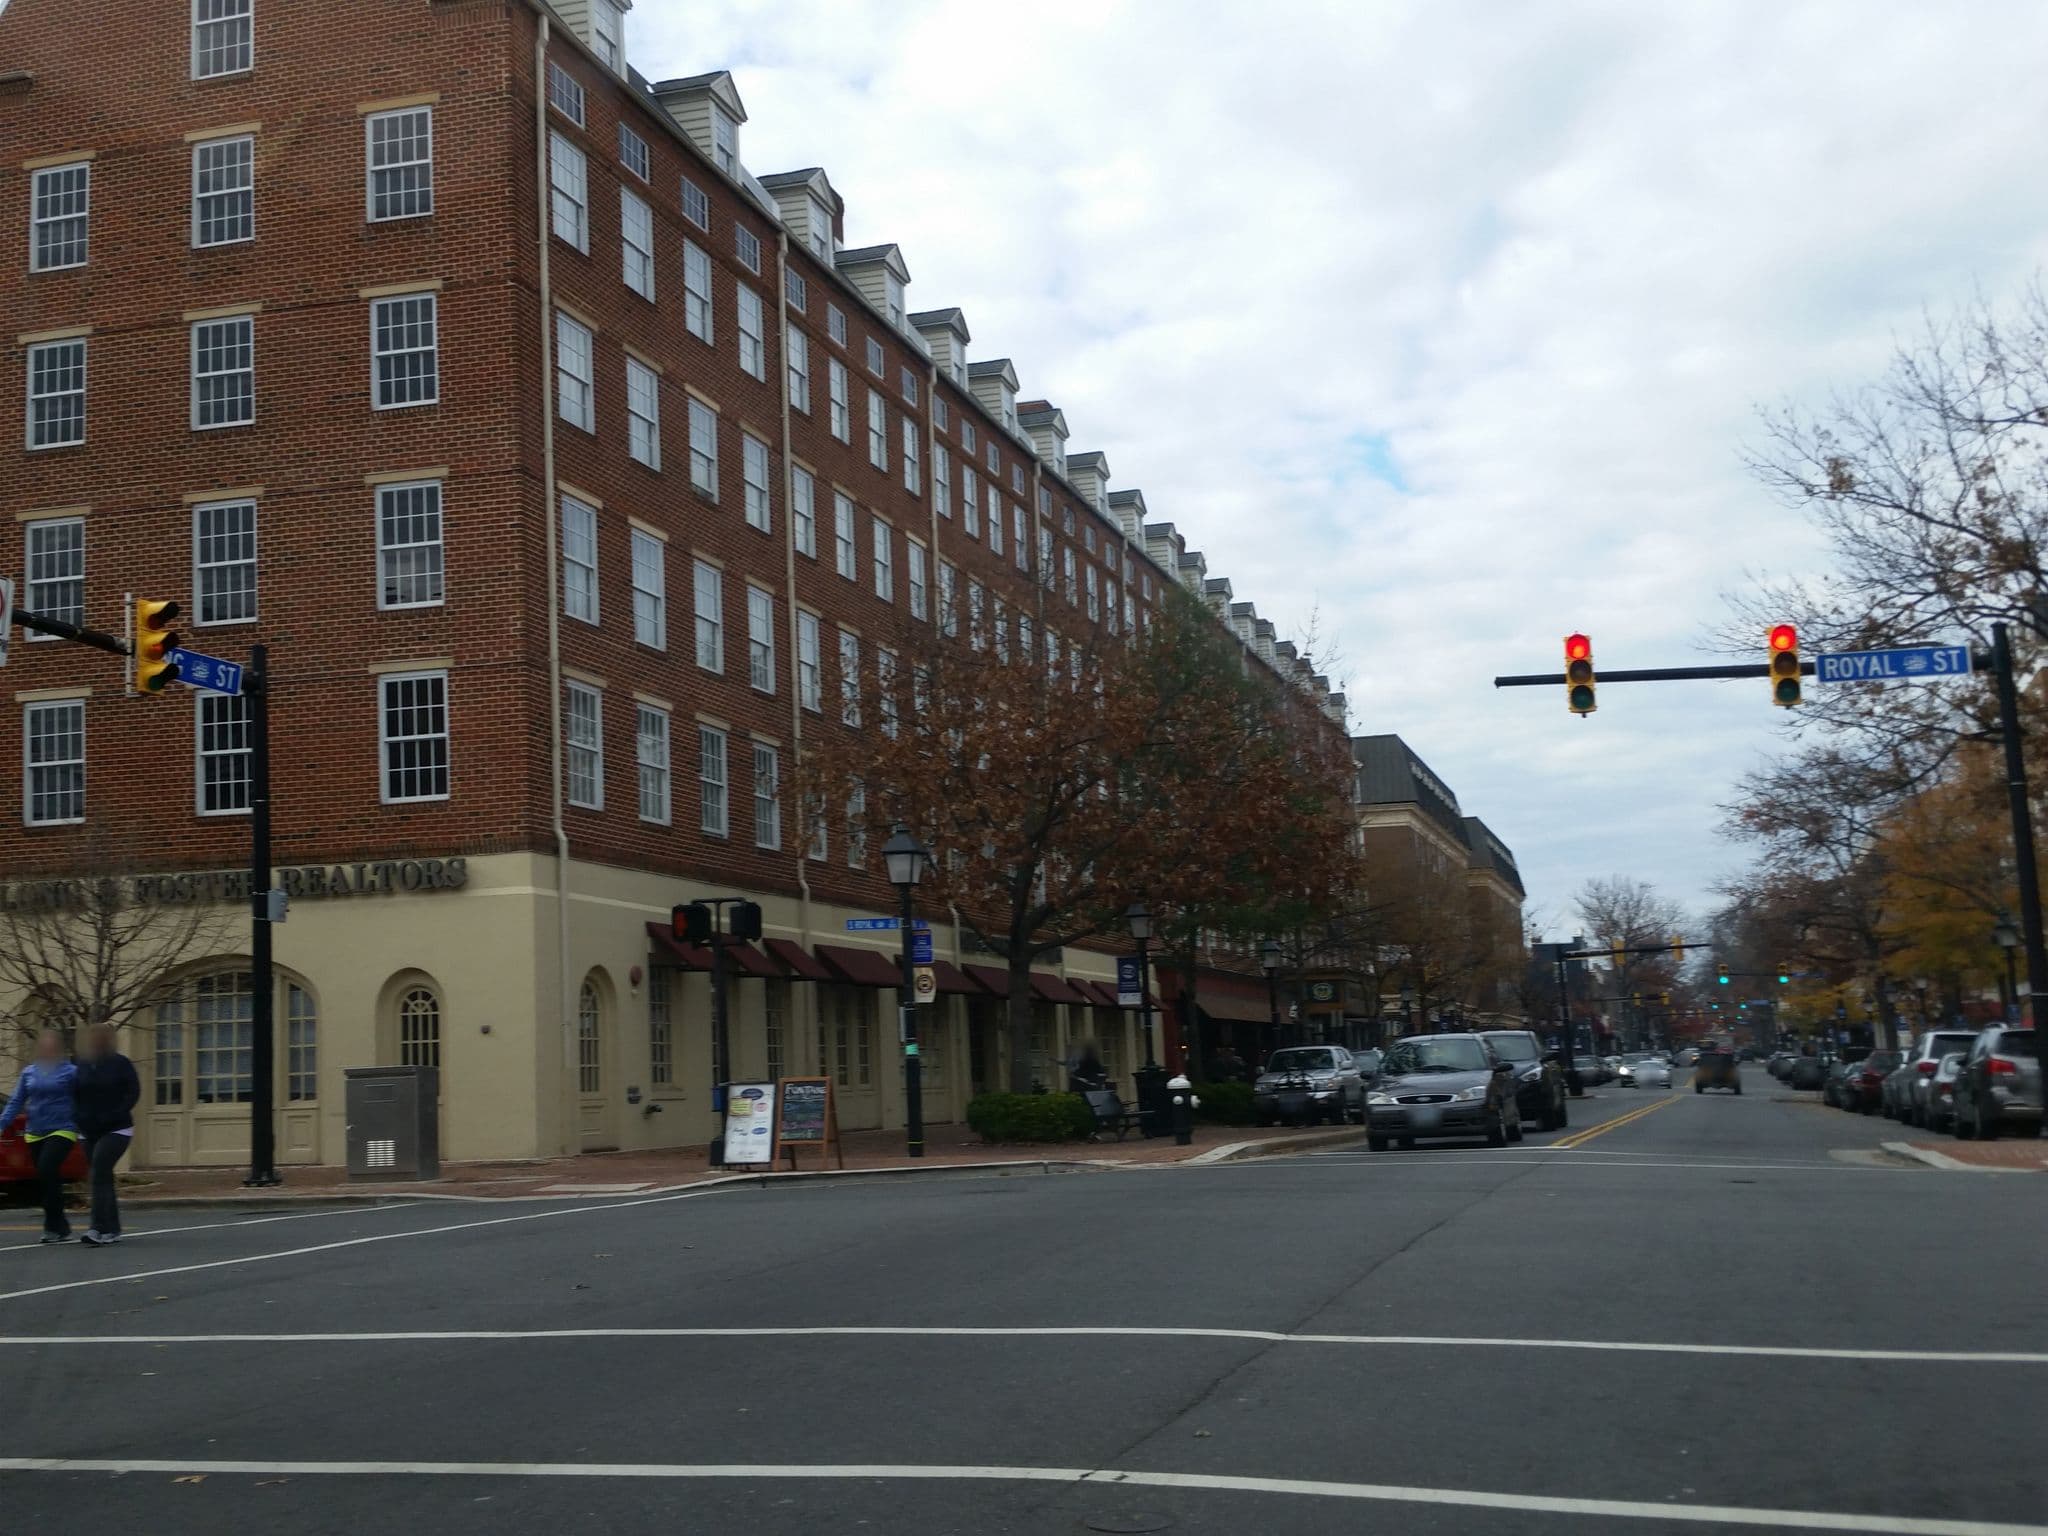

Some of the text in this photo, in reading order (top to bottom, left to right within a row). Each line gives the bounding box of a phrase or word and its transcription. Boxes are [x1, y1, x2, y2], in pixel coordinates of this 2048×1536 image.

[215, 664, 237, 689] ST
[1824, 650, 1961, 679] ROYAL ST
[278, 857, 467, 897] REALTORS
